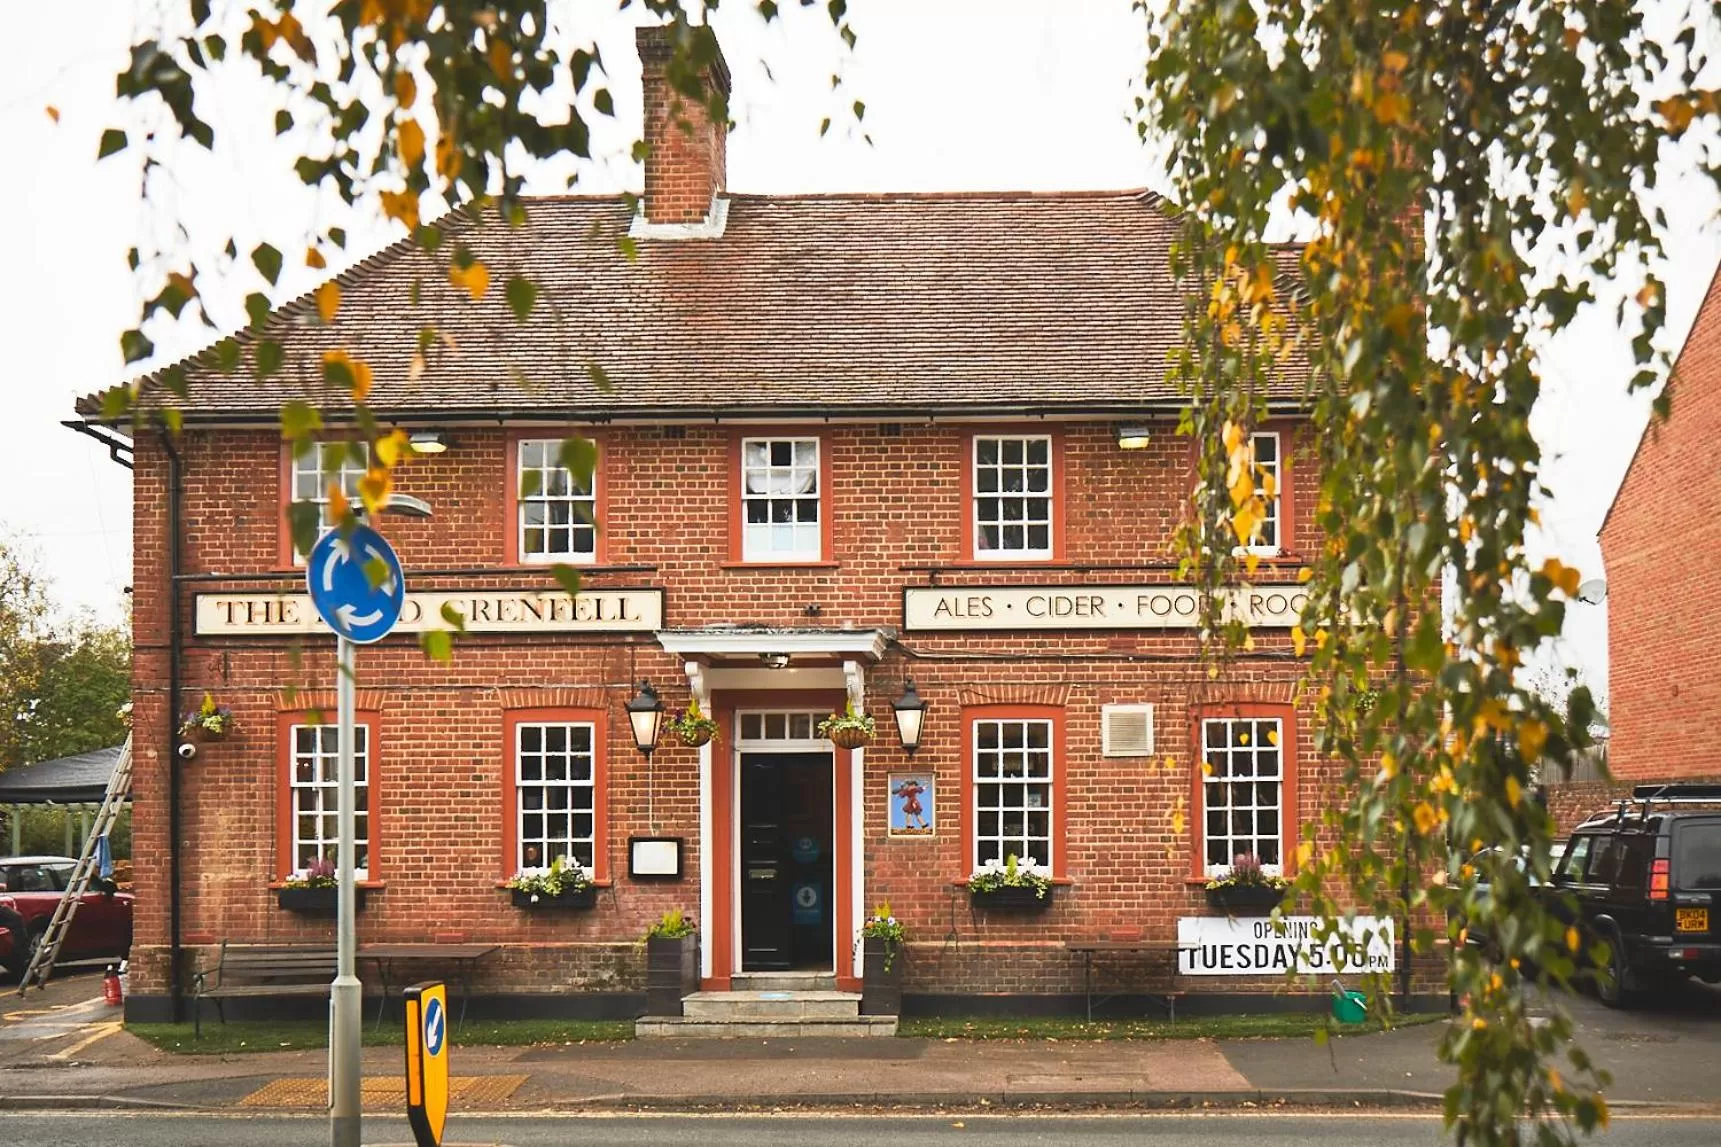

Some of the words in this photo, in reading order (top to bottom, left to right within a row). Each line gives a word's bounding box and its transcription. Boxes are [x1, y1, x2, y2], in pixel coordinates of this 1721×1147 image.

[216, 600, 301, 625] THE
[934, 596, 993, 617] ALES
[1026, 595, 1107, 617] CIDER
[1184, 944, 1302, 969] TUESDAY
